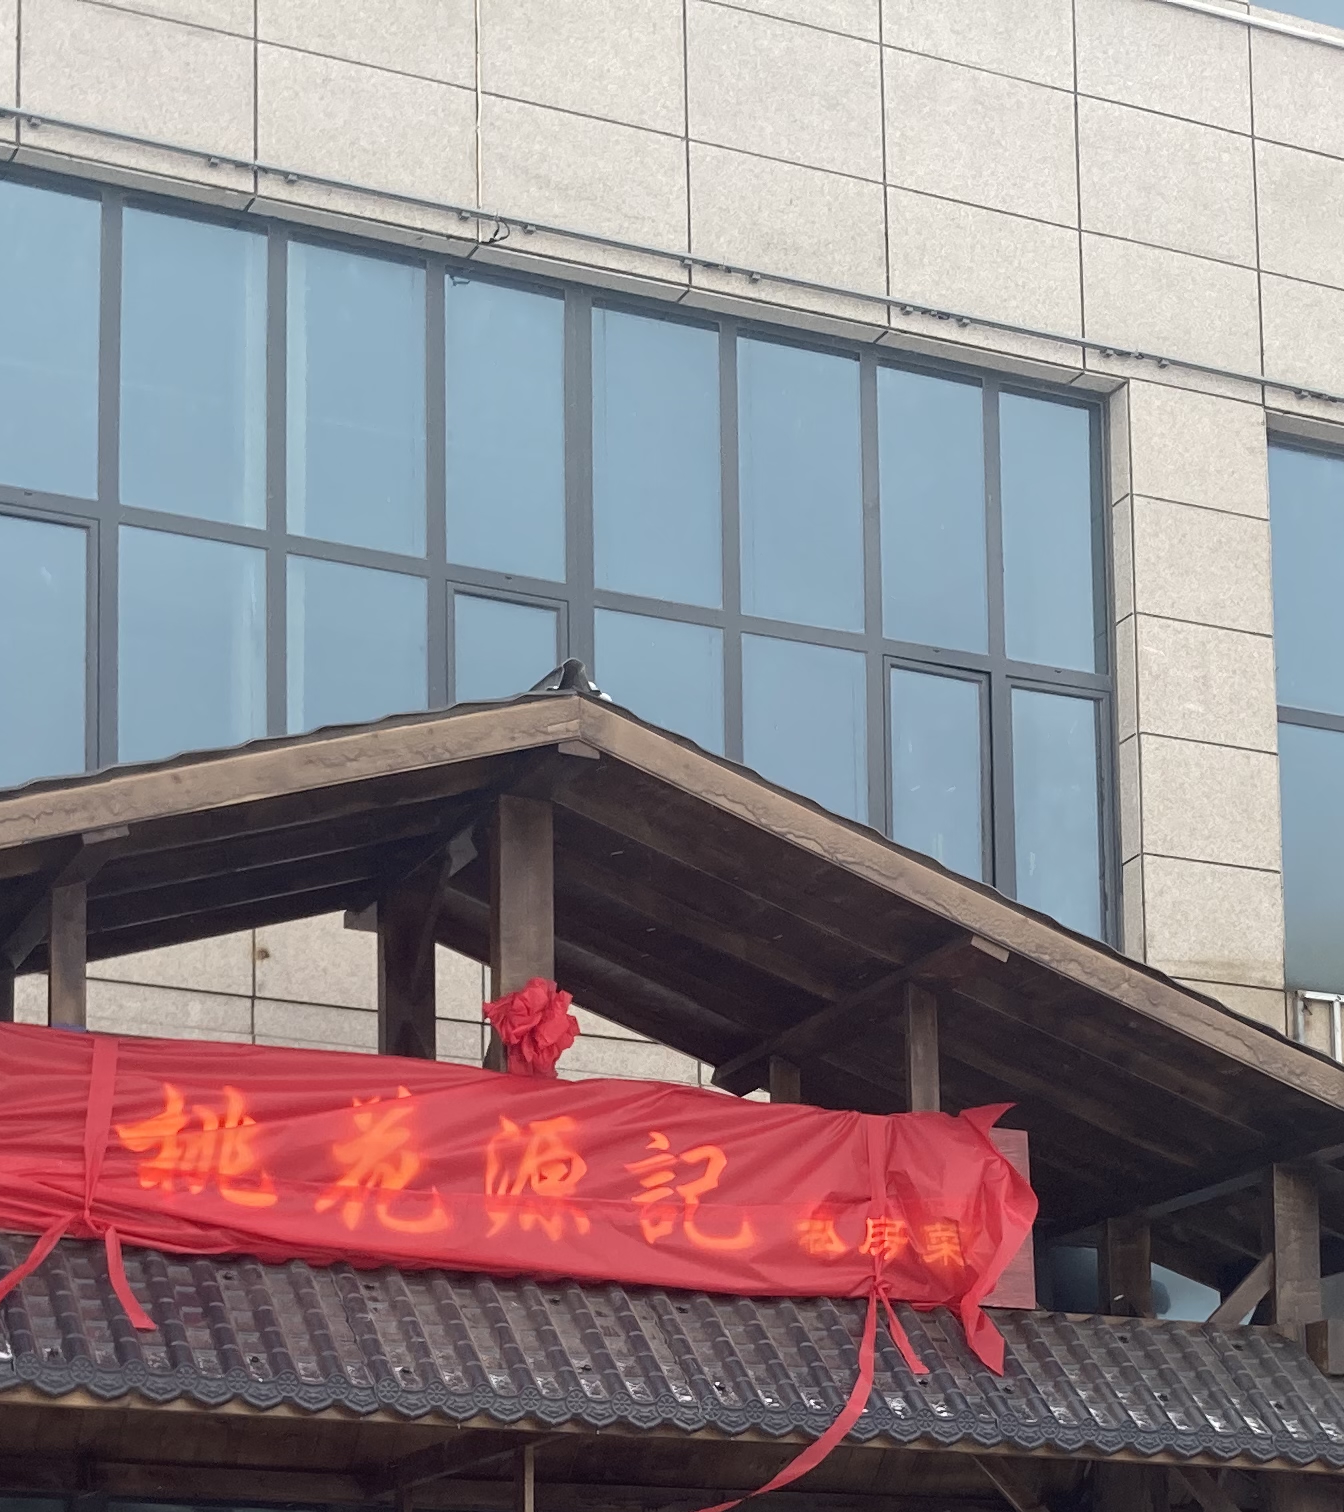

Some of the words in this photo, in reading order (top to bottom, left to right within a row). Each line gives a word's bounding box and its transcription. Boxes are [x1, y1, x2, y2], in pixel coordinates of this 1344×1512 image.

[115, 1083, 760, 1250] 桃花源記
[794, 1214, 969, 1267] 私房菜
